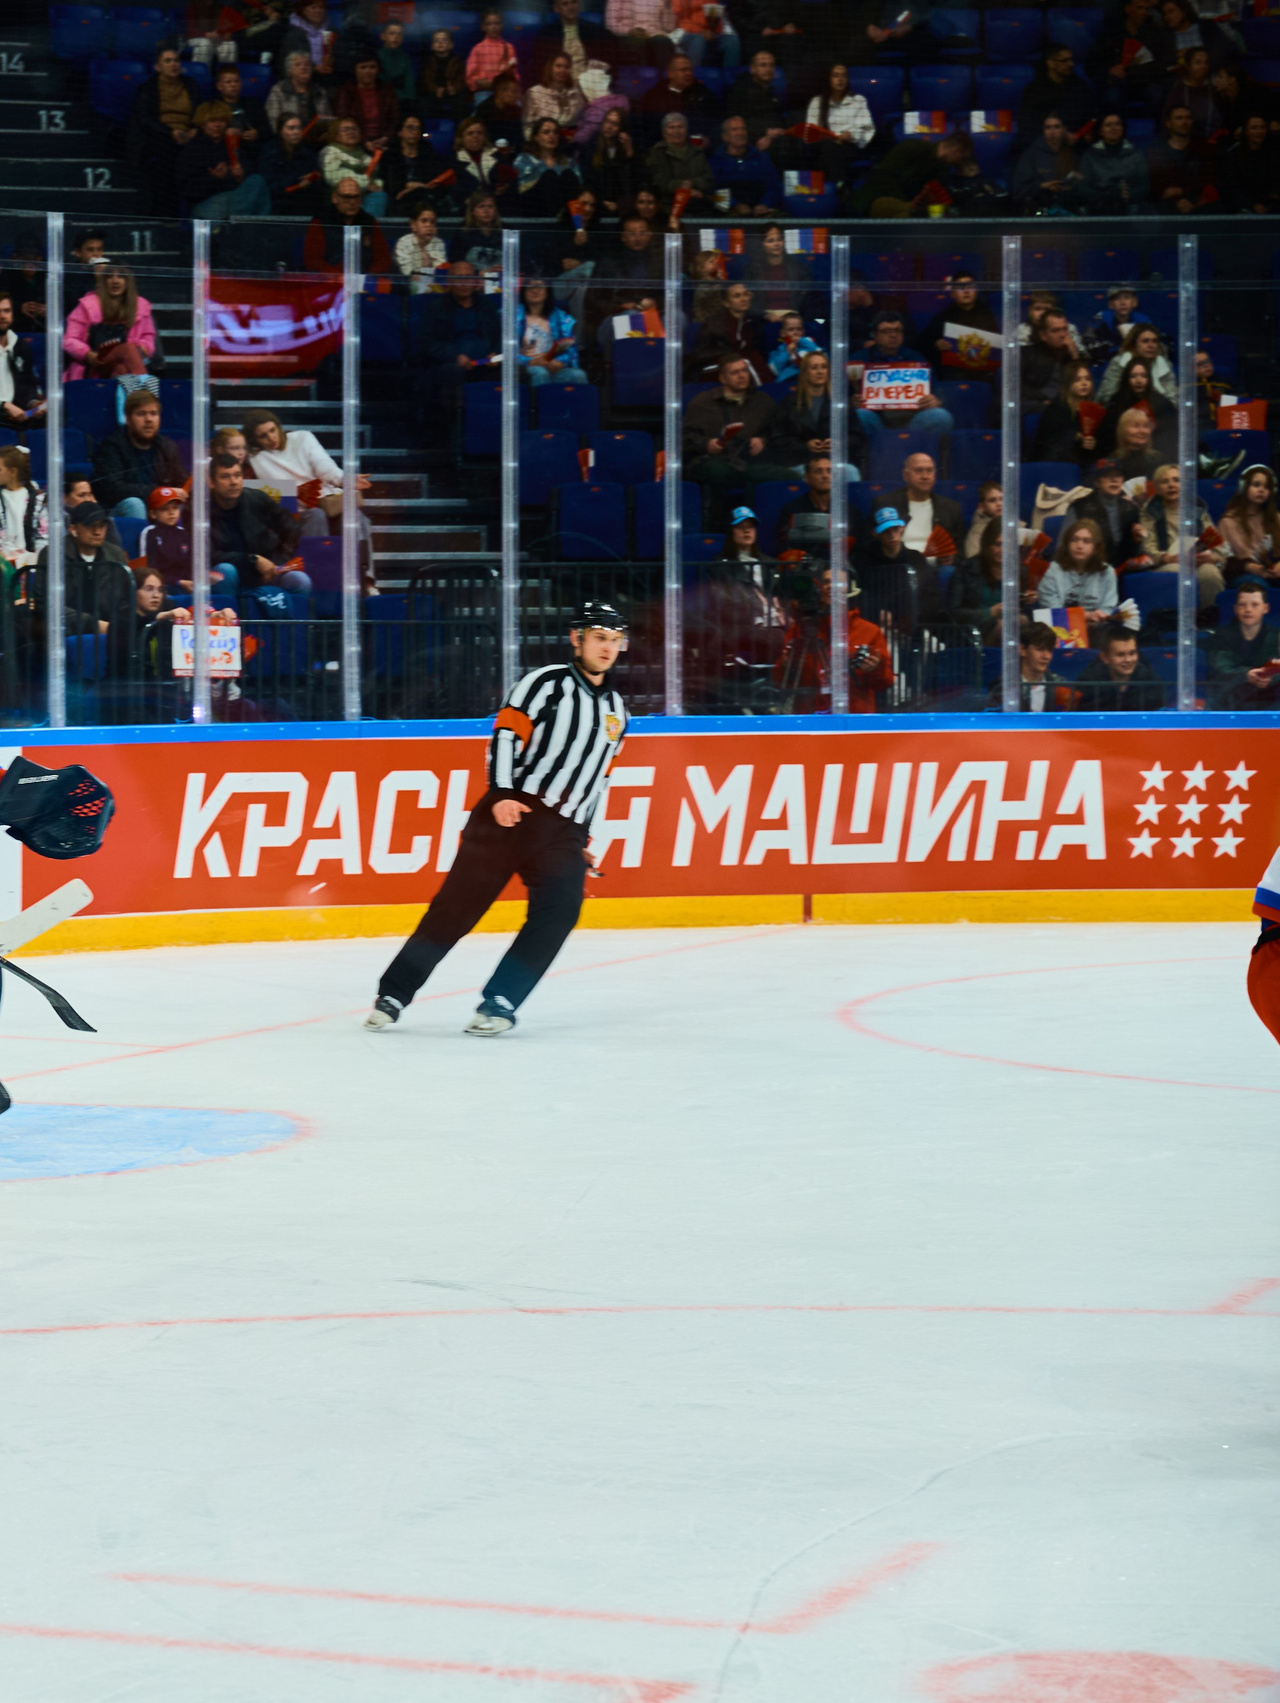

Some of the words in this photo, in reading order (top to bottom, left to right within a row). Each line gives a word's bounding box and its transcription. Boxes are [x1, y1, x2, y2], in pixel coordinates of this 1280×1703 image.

[37, 110, 66, 132] 13
[83, 167, 112, 189] 12
[130, 230, 153, 252] 11
[172, 766, 656, 878] КРАСЯ
[671, 760, 1107, 867] МАШИНА
